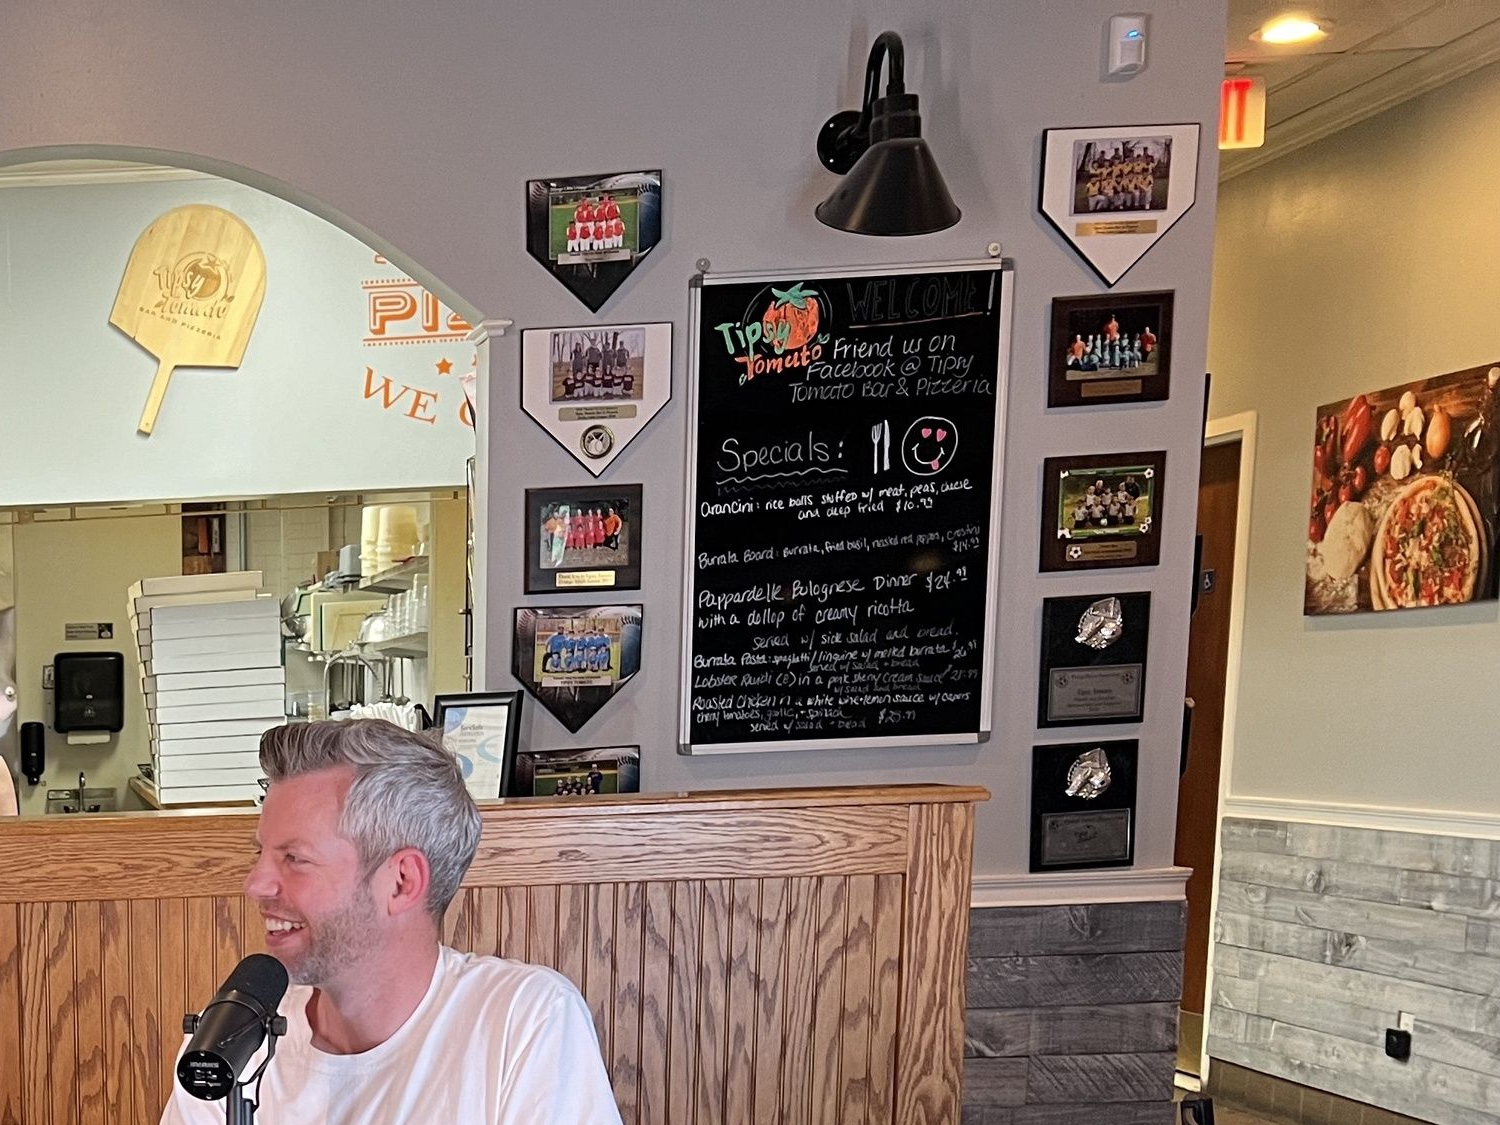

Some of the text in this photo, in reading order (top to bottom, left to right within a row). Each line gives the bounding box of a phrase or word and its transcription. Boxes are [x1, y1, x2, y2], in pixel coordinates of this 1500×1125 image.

[1220, 79, 1253, 143] IT
[714, 321, 791, 361] Tipsy
[834, 334, 955, 359] Friend us on
[735, 345, 822, 380] Tomato
[806, 359, 896, 381] Facebook
[901, 356, 921, 376] @
[364, 366, 439, 425] WE
[788, 383, 854, 403] Tomato
[896, 377, 909, 397] &
[717, 431, 845, 473] Specials:
[765, 499, 785, 511] rice
[789, 495, 813, 508] balls
[861, 488, 873, 503] w/
[879, 483, 907, 498] meat,
[910, 482, 939, 498] peas,
[941, 478, 973, 492] cheese
[798, 508, 820, 520] and
[827, 506, 851, 518] deep
[858, 500, 884, 513] fried
[698, 550, 739, 569] Burrata
[698, 583, 785, 610] Pappardelle
[792, 579, 866, 602] Bolognese
[873, 573, 917, 590] Dinner
[698, 598, 915, 629] with a dollop of creamy ricotta
[752, 633, 790, 650] served
[801, 629, 816, 650] w/
[821, 630, 842, 644] side
[846, 628, 878, 644] salad
[886, 624, 909, 640] and
[799, 673, 811, 686] in
[815, 675, 823, 685] a
